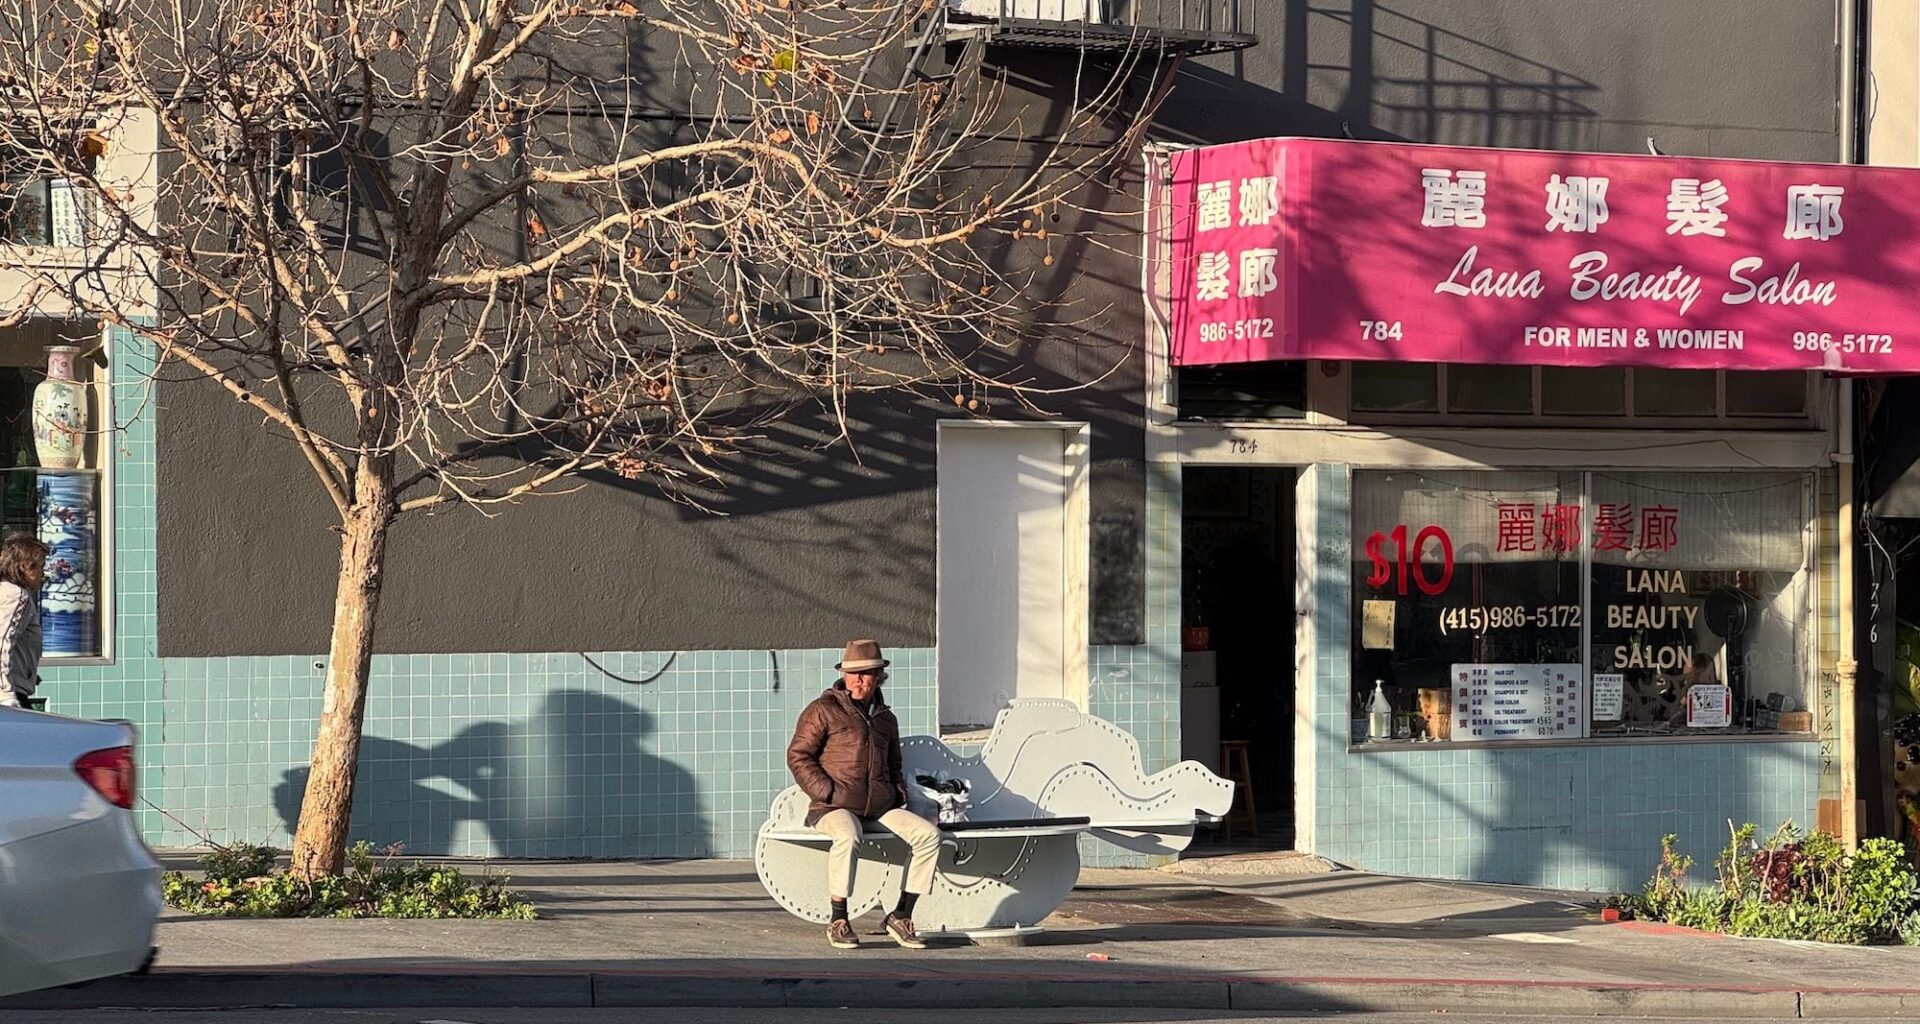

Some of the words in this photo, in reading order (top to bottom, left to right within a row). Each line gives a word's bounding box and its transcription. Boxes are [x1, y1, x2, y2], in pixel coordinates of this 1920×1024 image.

[1197, 176, 1279, 233] 麗娜
[1196, 248, 1278, 302] 髮廊
[1434, 245, 1545, 299] Lana
[1568, 251, 1702, 317] Beauty
[1721, 256, 1838, 307] Salon
[1199, 317, 1275, 343] 986-5172
[1359, 320, 1403, 342] 784
[1524, 326, 1571, 349] FOR
[1577, 327, 1628, 349] MEN
[1633, 329, 1651, 349] &
[1657, 329, 1744, 350] WOMEN
[1792, 332, 1893, 354] 986-5172
[1230, 438, 1258, 454] 784
[1496, 503, 1679, 553] 麗娜髮廊
[1364, 524, 1455, 596] $10
[1626, 570, 1687, 595] LANA
[1439, 604, 1581, 636] (415)986-5172
[1608, 604, 1699, 630] BEAUTY
[1869, 583, 1880, 644] 776
[1614, 645, 1694, 670] SALON
